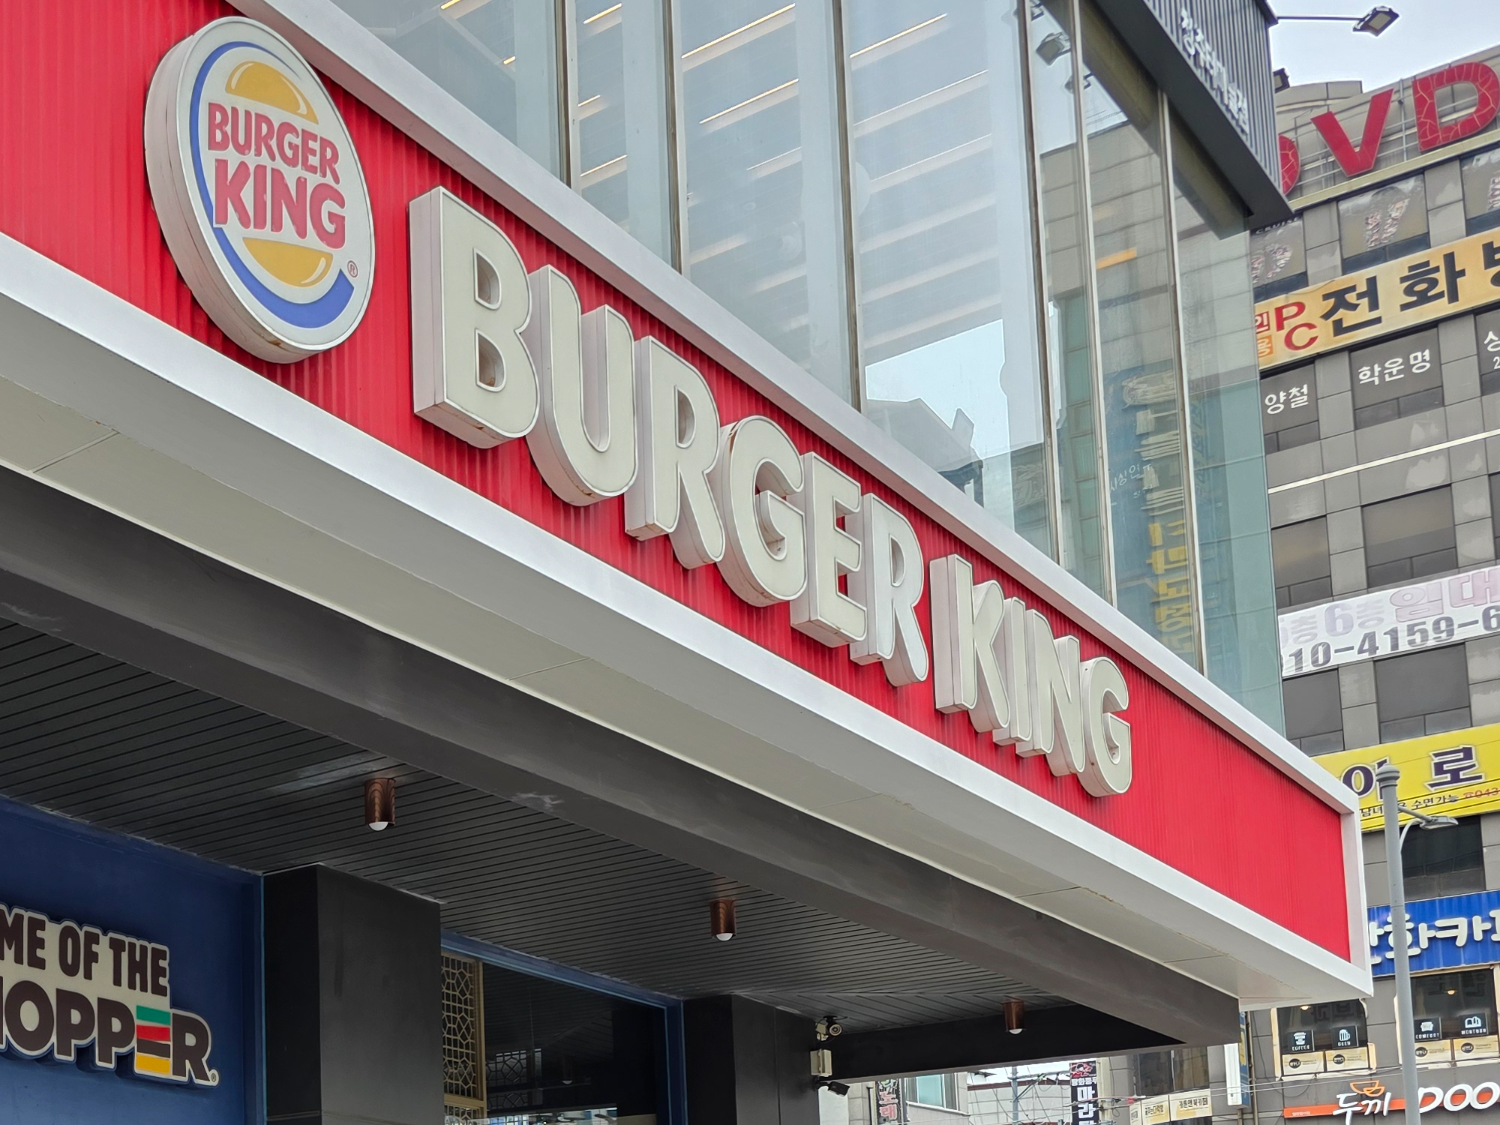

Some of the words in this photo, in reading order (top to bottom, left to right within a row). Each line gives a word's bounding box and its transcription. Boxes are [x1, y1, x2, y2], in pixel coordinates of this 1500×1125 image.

[208, 102, 340, 185] BURGER
[1278, 62, 1500, 196] VD
[214, 158, 346, 249] KING
[409, 186, 929, 687] BURGER
[930, 554, 1132, 797] KING
[1280, 605, 1500, 673] 10-4159-6
[58, 925, 100, 980] OF
[109, 937, 169, 997] THE
[1369, 906, 1500, 964] 화카
